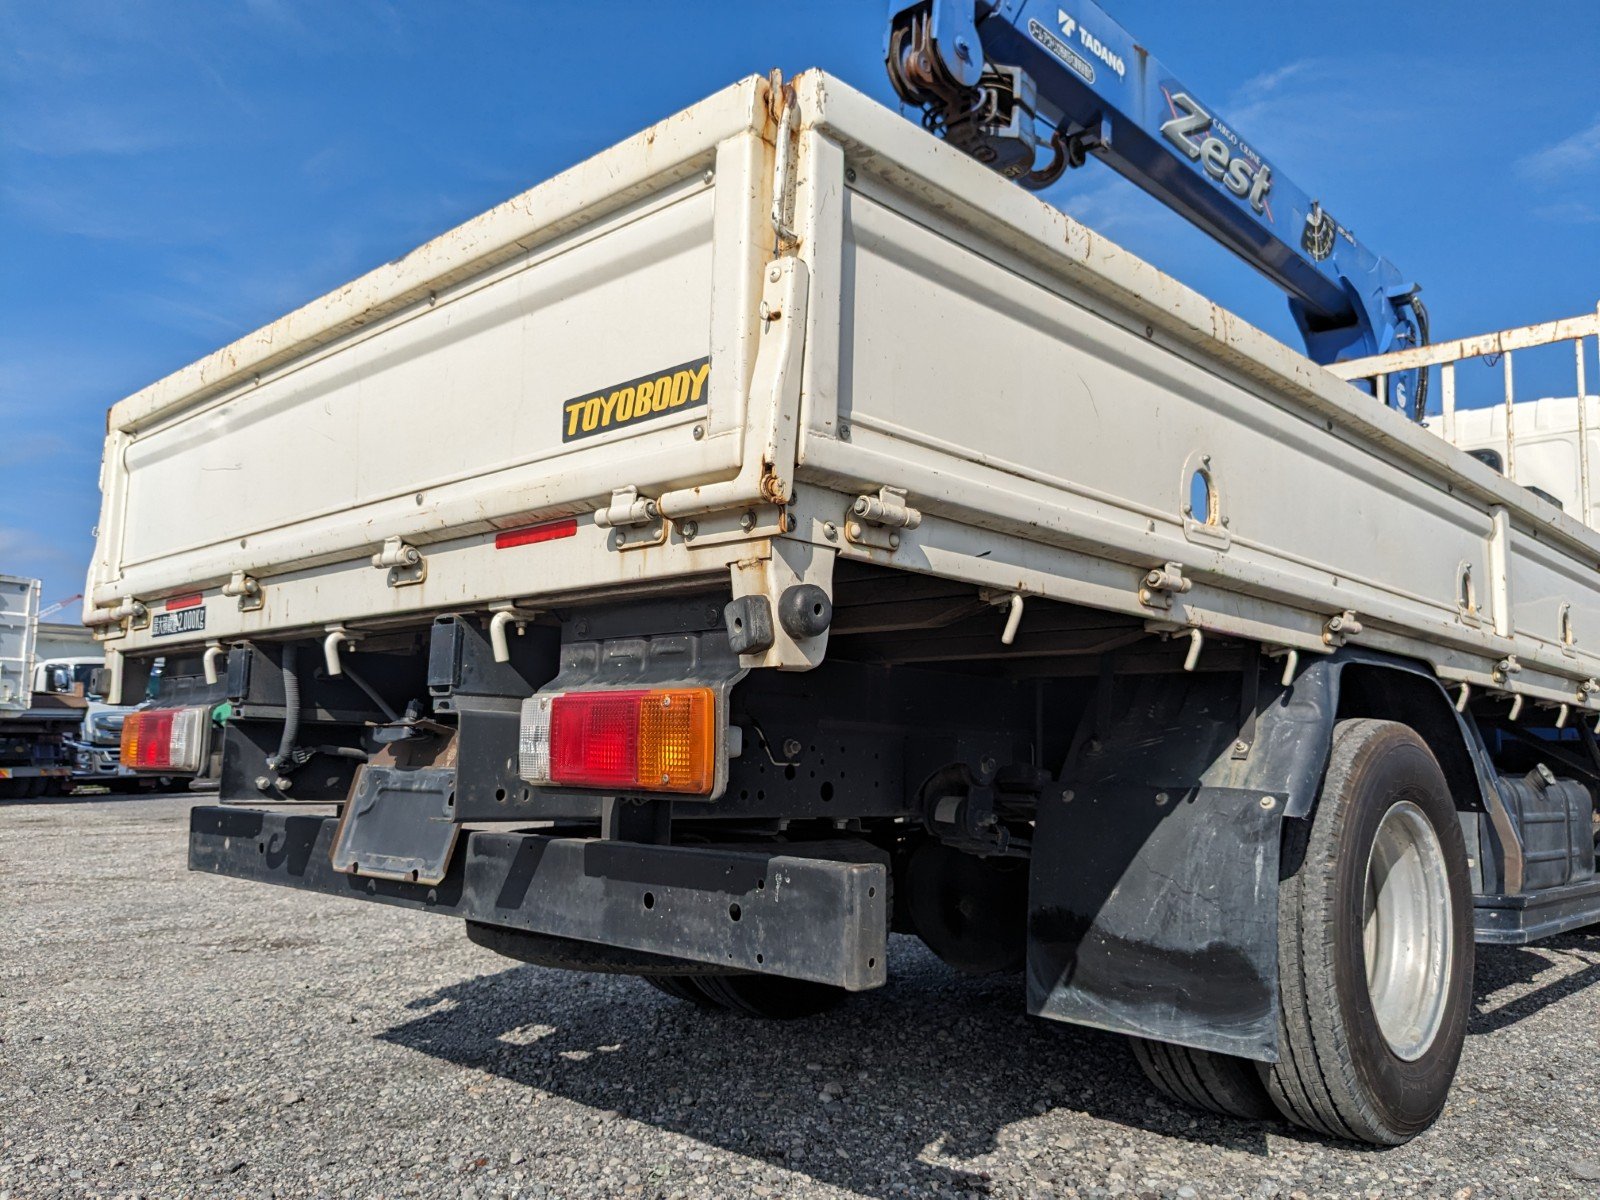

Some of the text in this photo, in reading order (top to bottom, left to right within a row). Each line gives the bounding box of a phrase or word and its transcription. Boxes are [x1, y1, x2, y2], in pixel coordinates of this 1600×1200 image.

[1079, 26, 1125, 76] TADANO
[1160, 93, 1270, 213] Zest
[1212, 119, 1238, 145] CARGO
[565, 363, 710, 436] TOYOBODY
